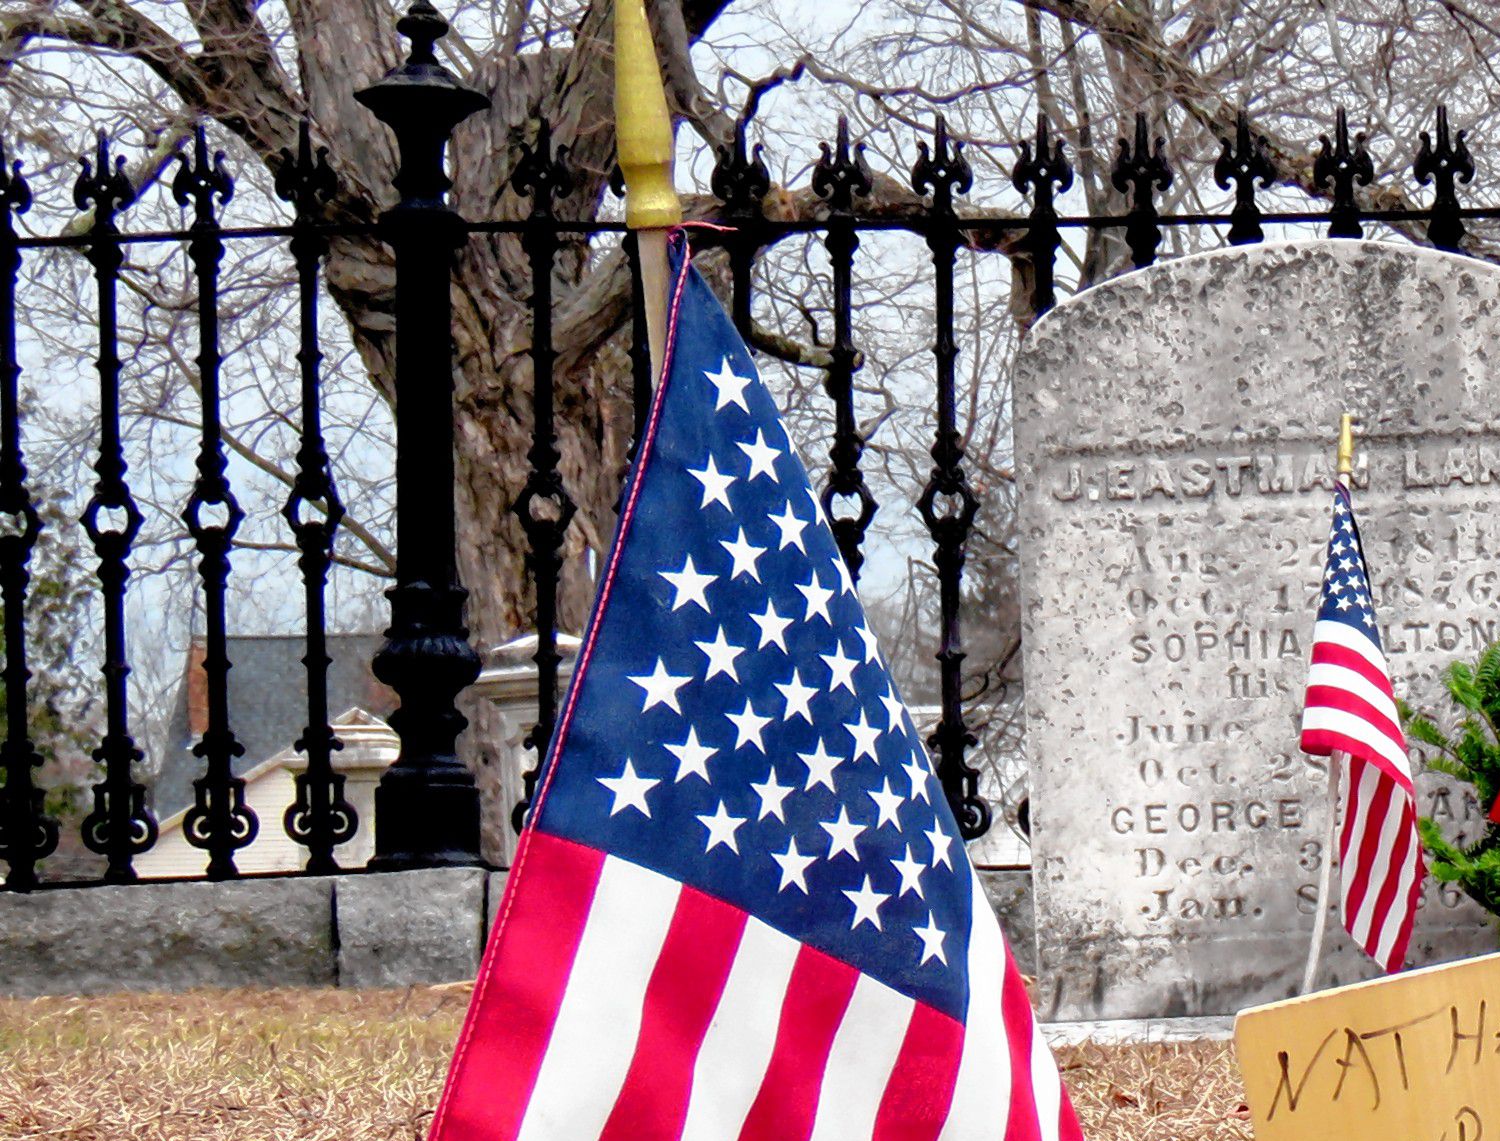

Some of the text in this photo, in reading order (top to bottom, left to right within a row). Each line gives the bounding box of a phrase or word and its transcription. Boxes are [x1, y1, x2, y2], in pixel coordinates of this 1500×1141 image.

[1129, 624, 1302, 664] SOPHIA
[1110, 799, 1304, 836] GEORGE
[1133, 847, 1254, 879] Dec.
[1141, 887, 1264, 922] Jan.
